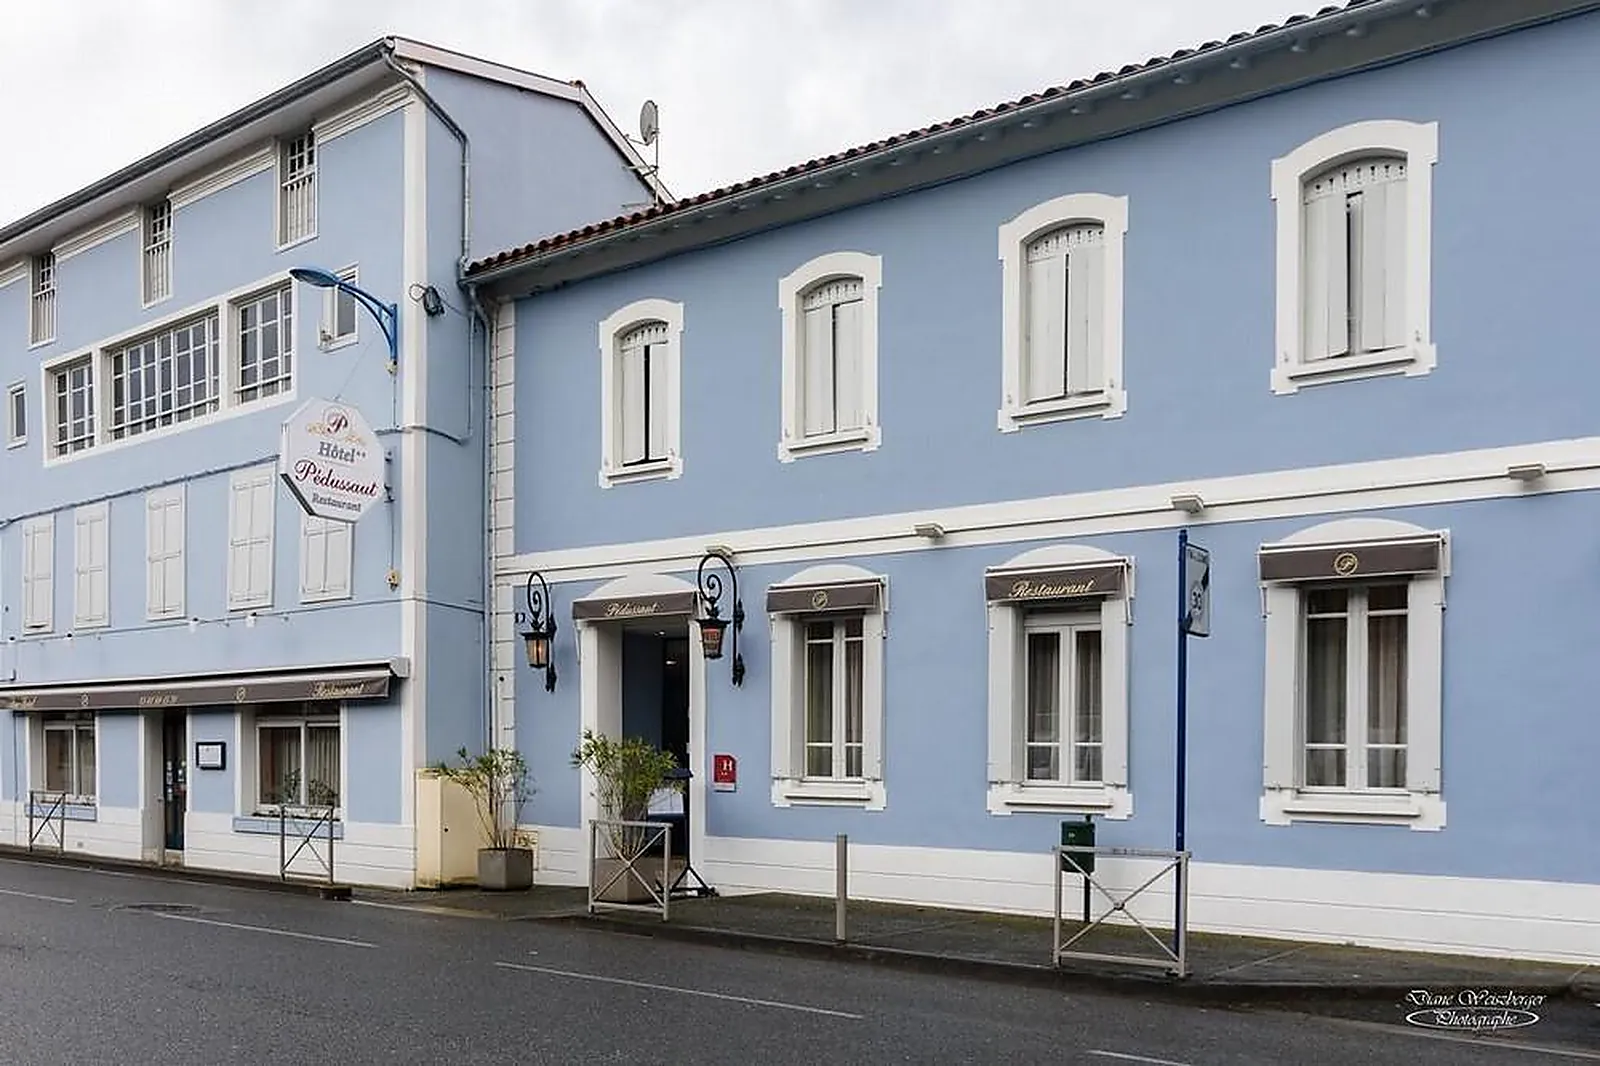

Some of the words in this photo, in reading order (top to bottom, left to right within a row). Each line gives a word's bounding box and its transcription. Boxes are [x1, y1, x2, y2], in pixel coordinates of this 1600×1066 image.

[294, 459, 378, 496] Pédussaut
[312, 493, 361, 512] Restaurant
[1007, 579, 1095, 598] Restaurant
